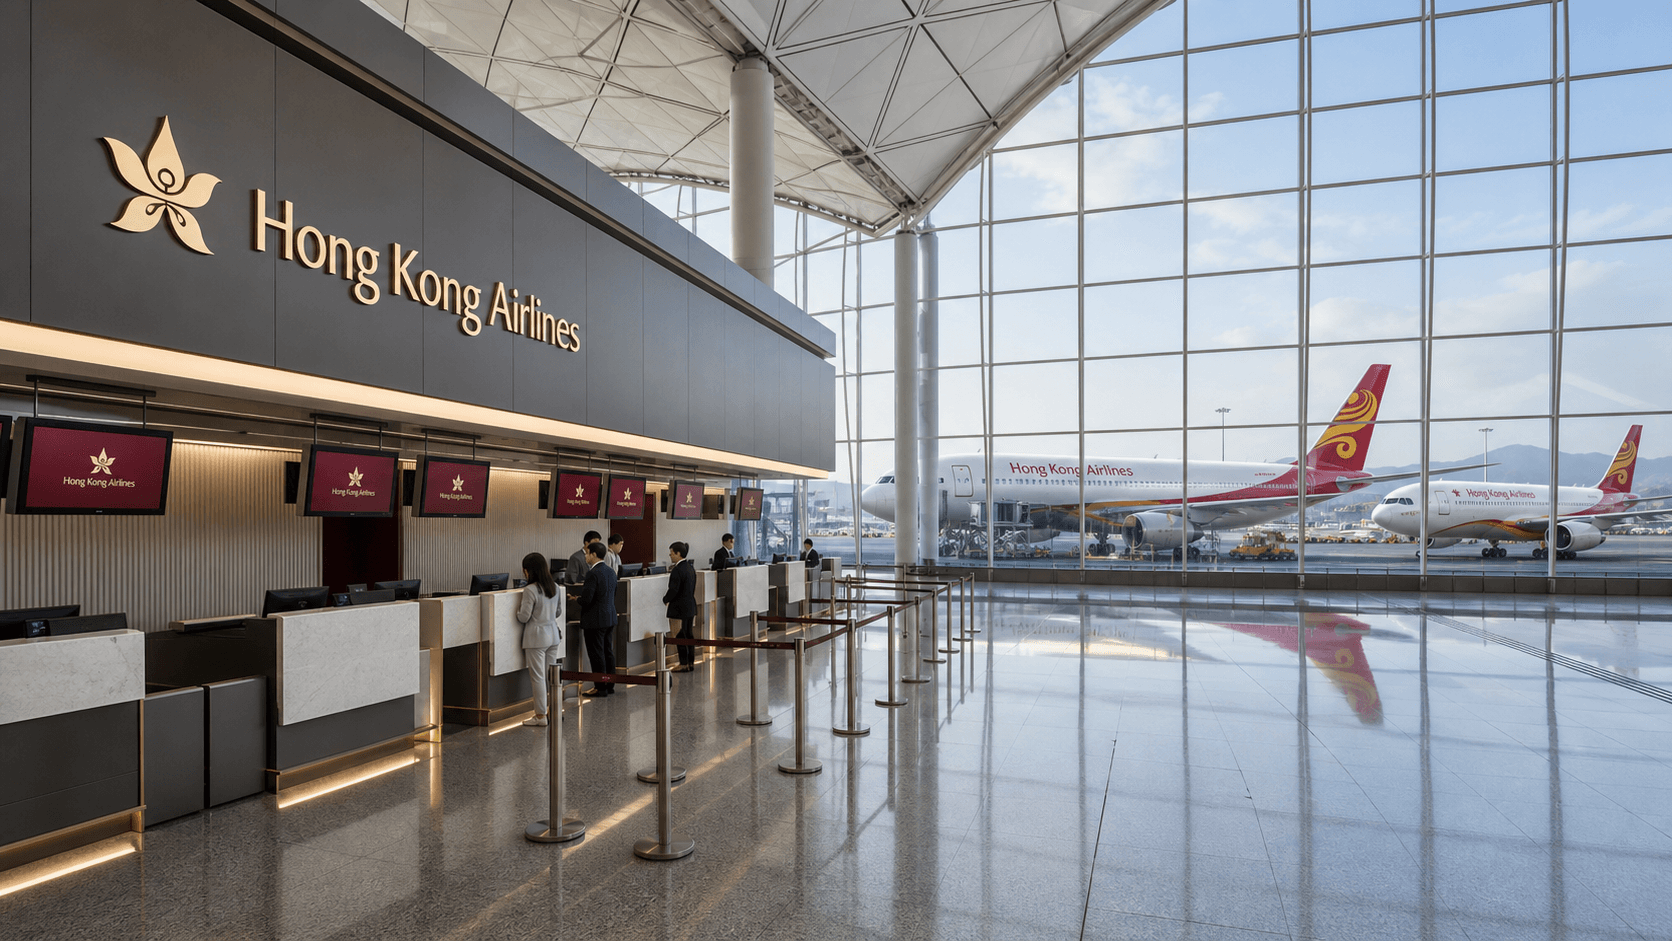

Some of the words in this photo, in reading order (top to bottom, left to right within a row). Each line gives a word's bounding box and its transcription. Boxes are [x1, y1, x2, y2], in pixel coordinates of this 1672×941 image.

[251, 188, 380, 305] Hong
[391, 242, 481, 336] Kong
[486, 281, 580, 352] Airlines
[1009, 462, 1048, 478] Hong
[63, 476, 86, 488] Hong
[87, 477, 107, 489] Kong
[108, 478, 136, 488] Airlines
